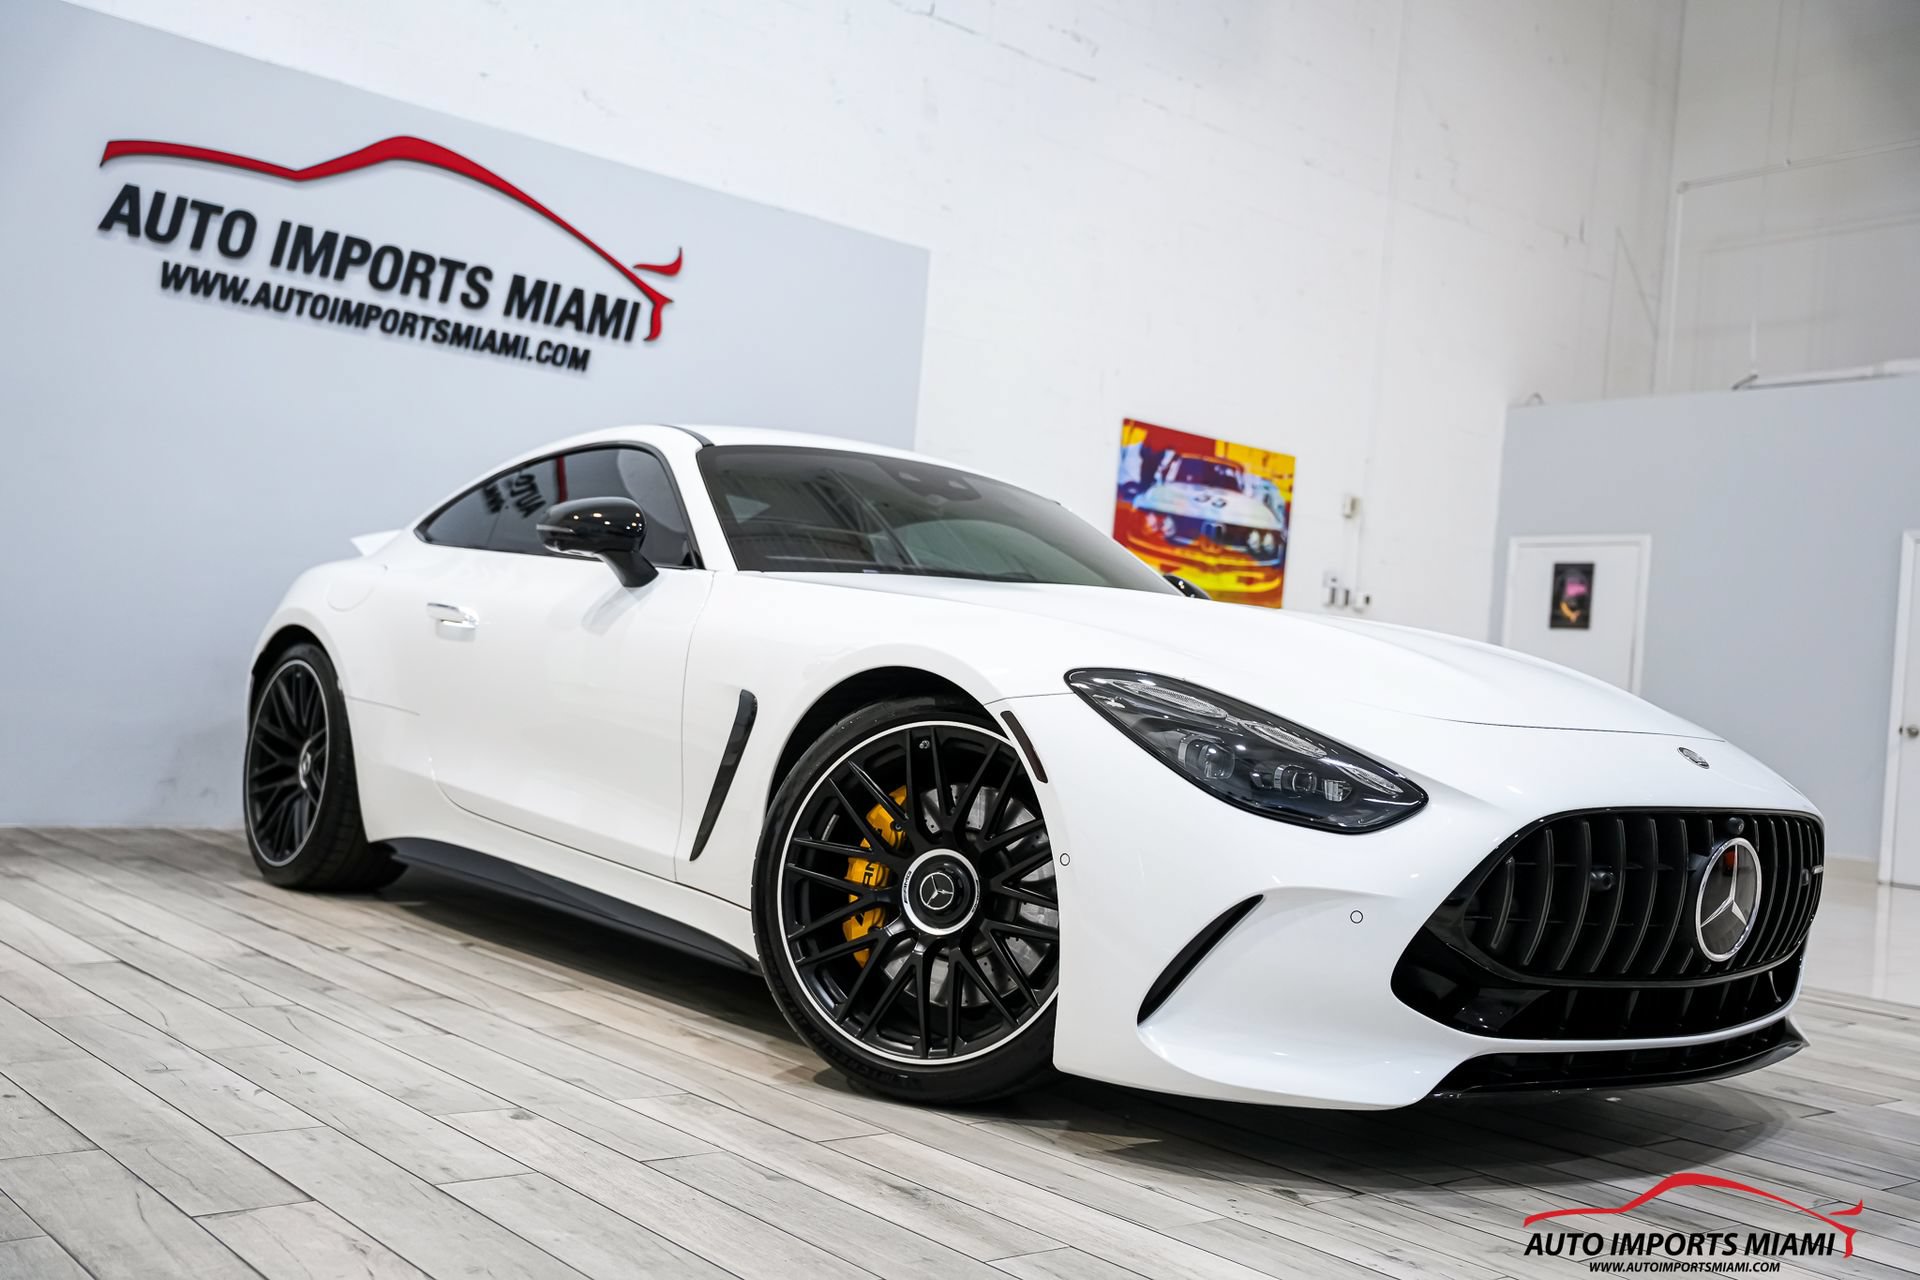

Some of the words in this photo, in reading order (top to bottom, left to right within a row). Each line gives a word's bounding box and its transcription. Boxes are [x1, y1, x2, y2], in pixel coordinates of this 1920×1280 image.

[97, 183, 258, 260] AUTO
[268, 220, 494, 311] IMPORTS
[503, 274, 642, 343] MIAMI
[160, 260, 592, 373] WWW.AUTOIMPORTSMIAMI.COM
